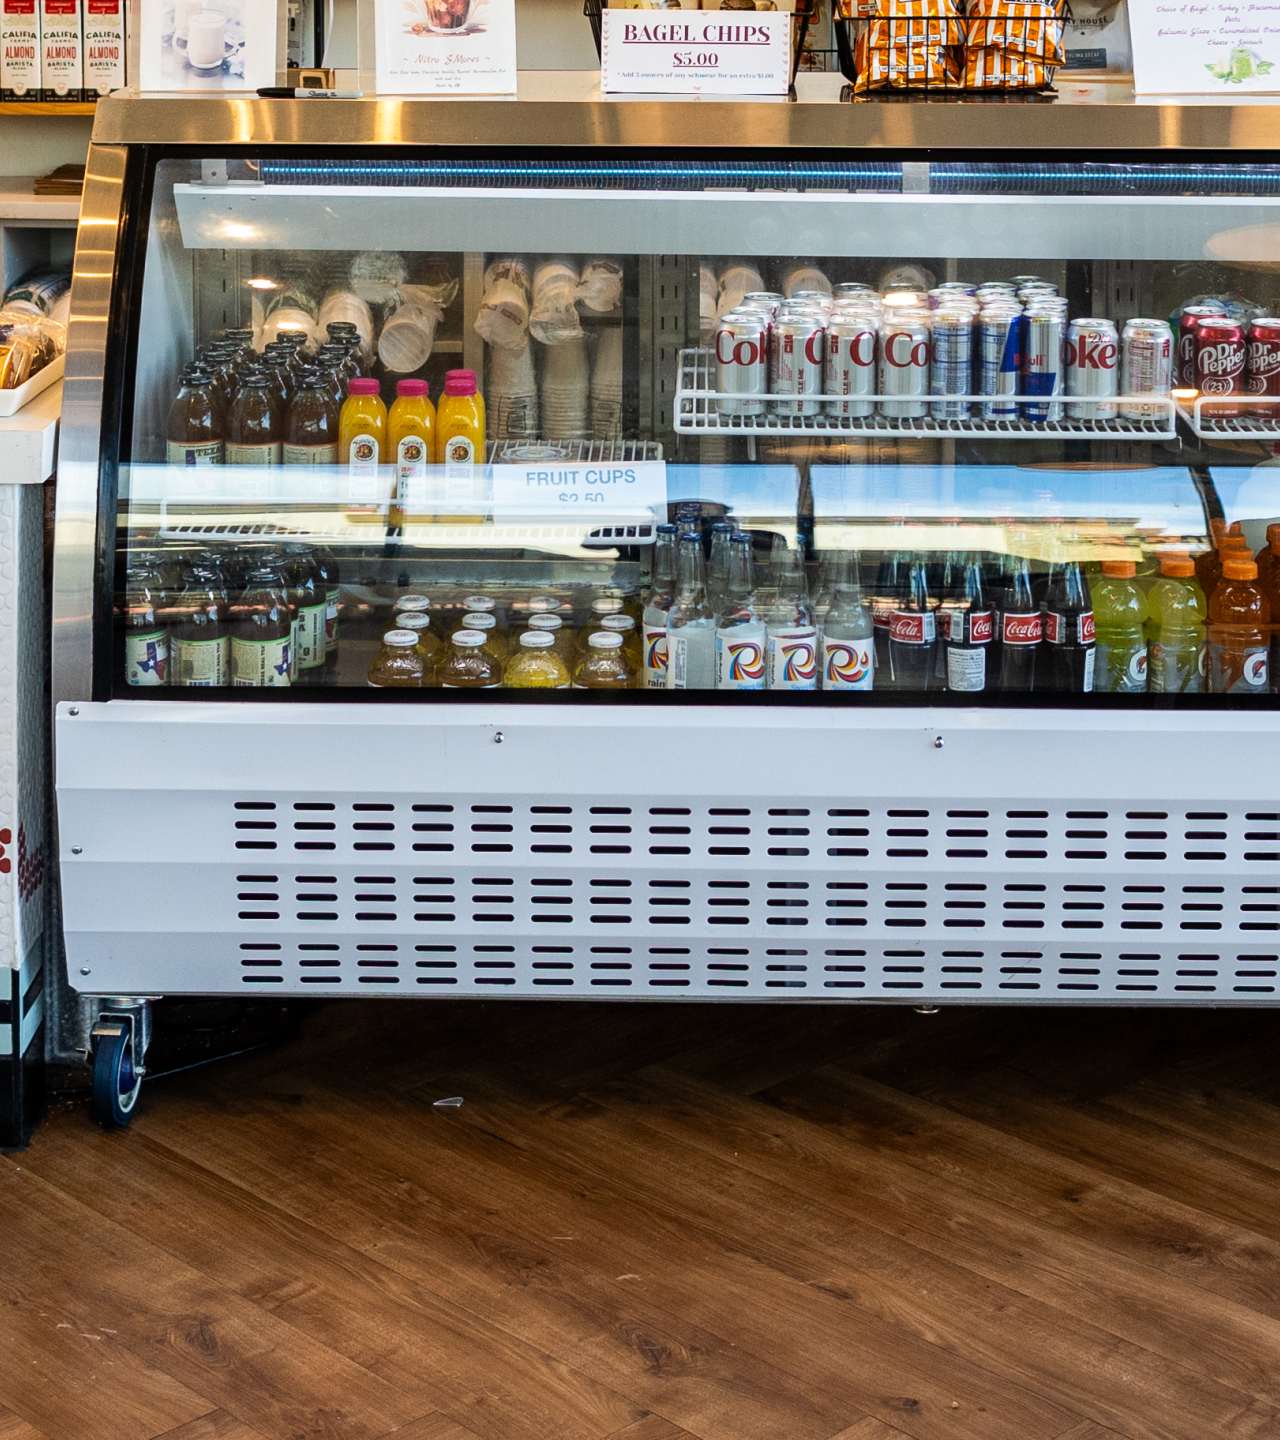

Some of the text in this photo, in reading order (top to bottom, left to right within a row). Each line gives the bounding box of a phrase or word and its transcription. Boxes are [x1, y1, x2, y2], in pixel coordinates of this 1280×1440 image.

[2, 30, 37, 40] CALIFIA
[43, 31, 78, 40] CALIFIA
[86, 31, 121, 40] CALIFIA
[623, 24, 771, 42] BAGEL CHIPS
[5, 46, 35, 59] ALMOND
[46, 46, 77, 59] ALMOND
[89, 46, 119, 60] ALMOND
[672, 51, 719, 67] $5.00
[1060, 334, 1118, 370] oke
[1219, 343, 1238, 359] Dr
[1251, 343, 1271, 359] Dr
[1200, 346, 1245, 375] Pepper
[1210, 381, 1222, 393] 23
[525, 468, 636, 487] FRUIT CUPS
